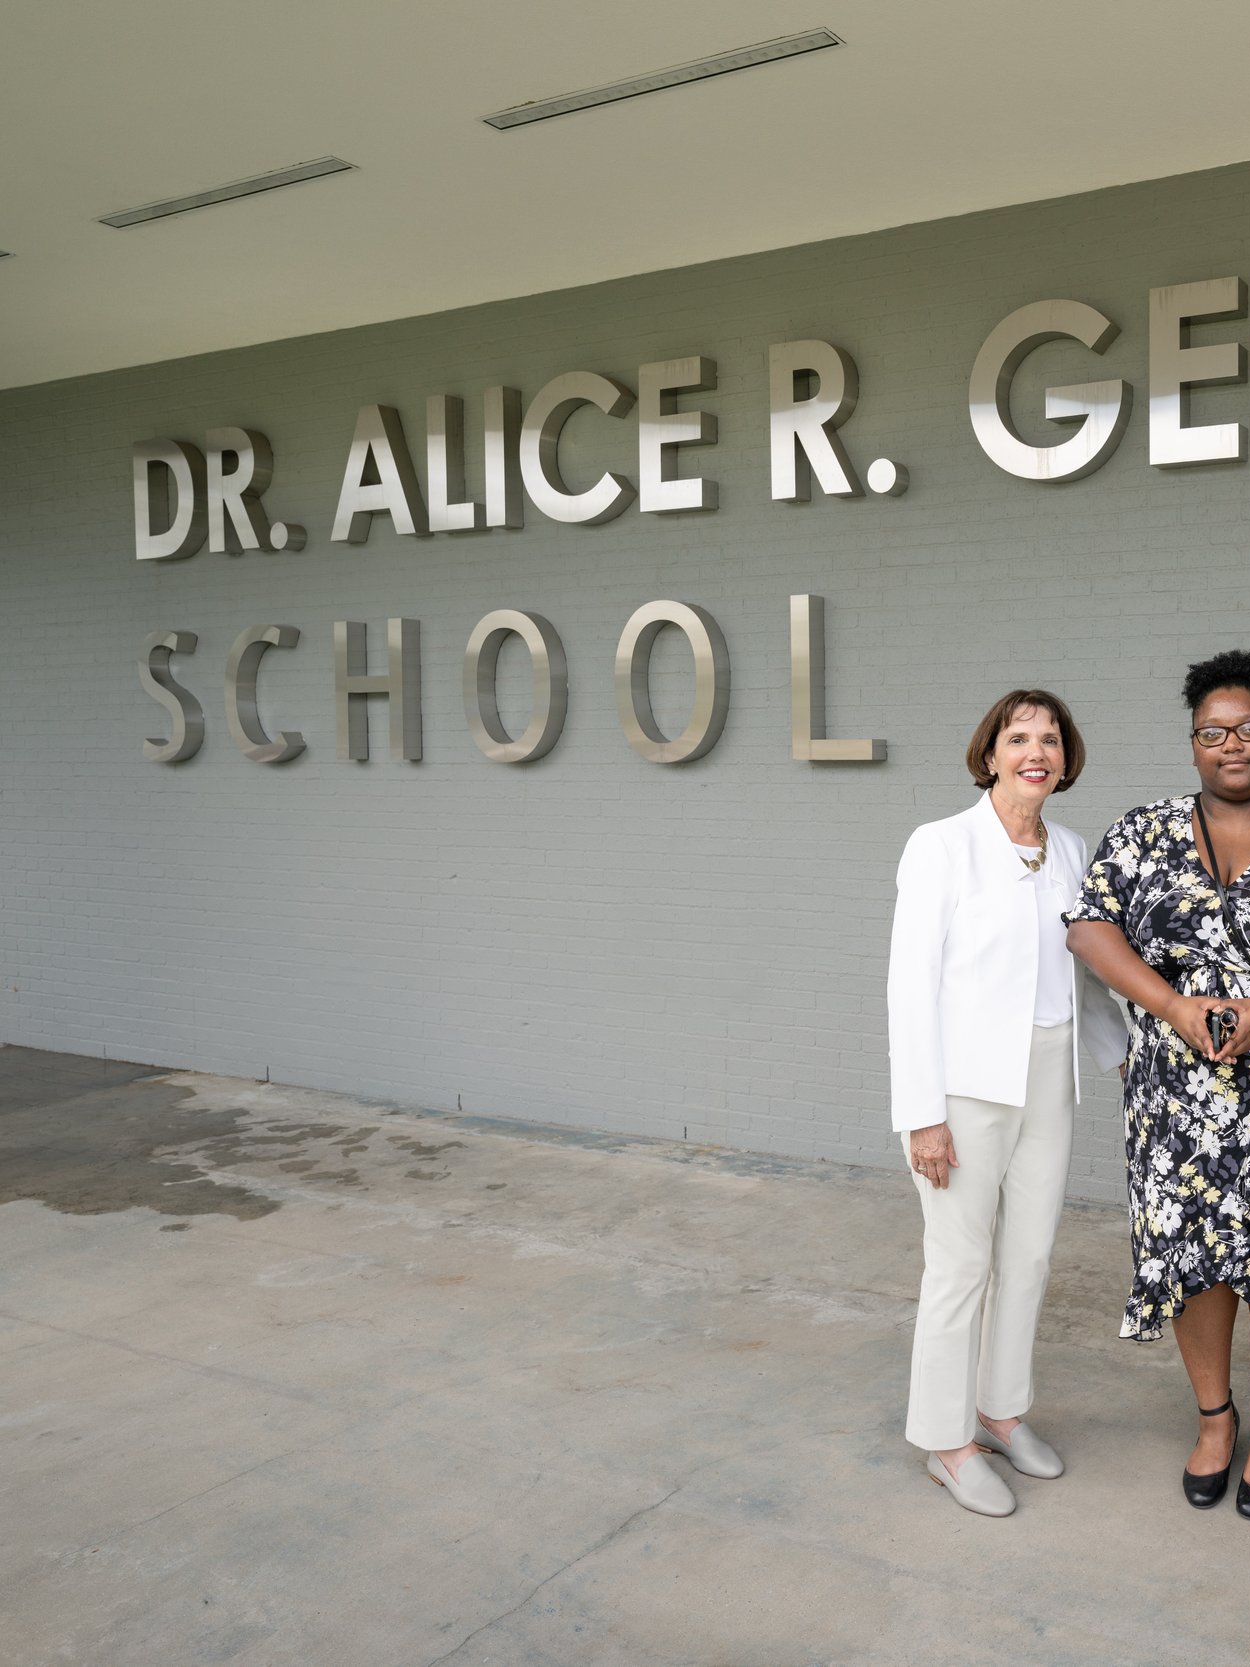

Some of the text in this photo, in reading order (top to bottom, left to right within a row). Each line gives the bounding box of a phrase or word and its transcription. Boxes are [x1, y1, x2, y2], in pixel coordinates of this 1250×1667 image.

[132, 426, 307, 561] DR.
[330, 355, 719, 544] ALICE
[768, 338, 909, 503] R.
[138, 593, 888, 765] SCHOOL
